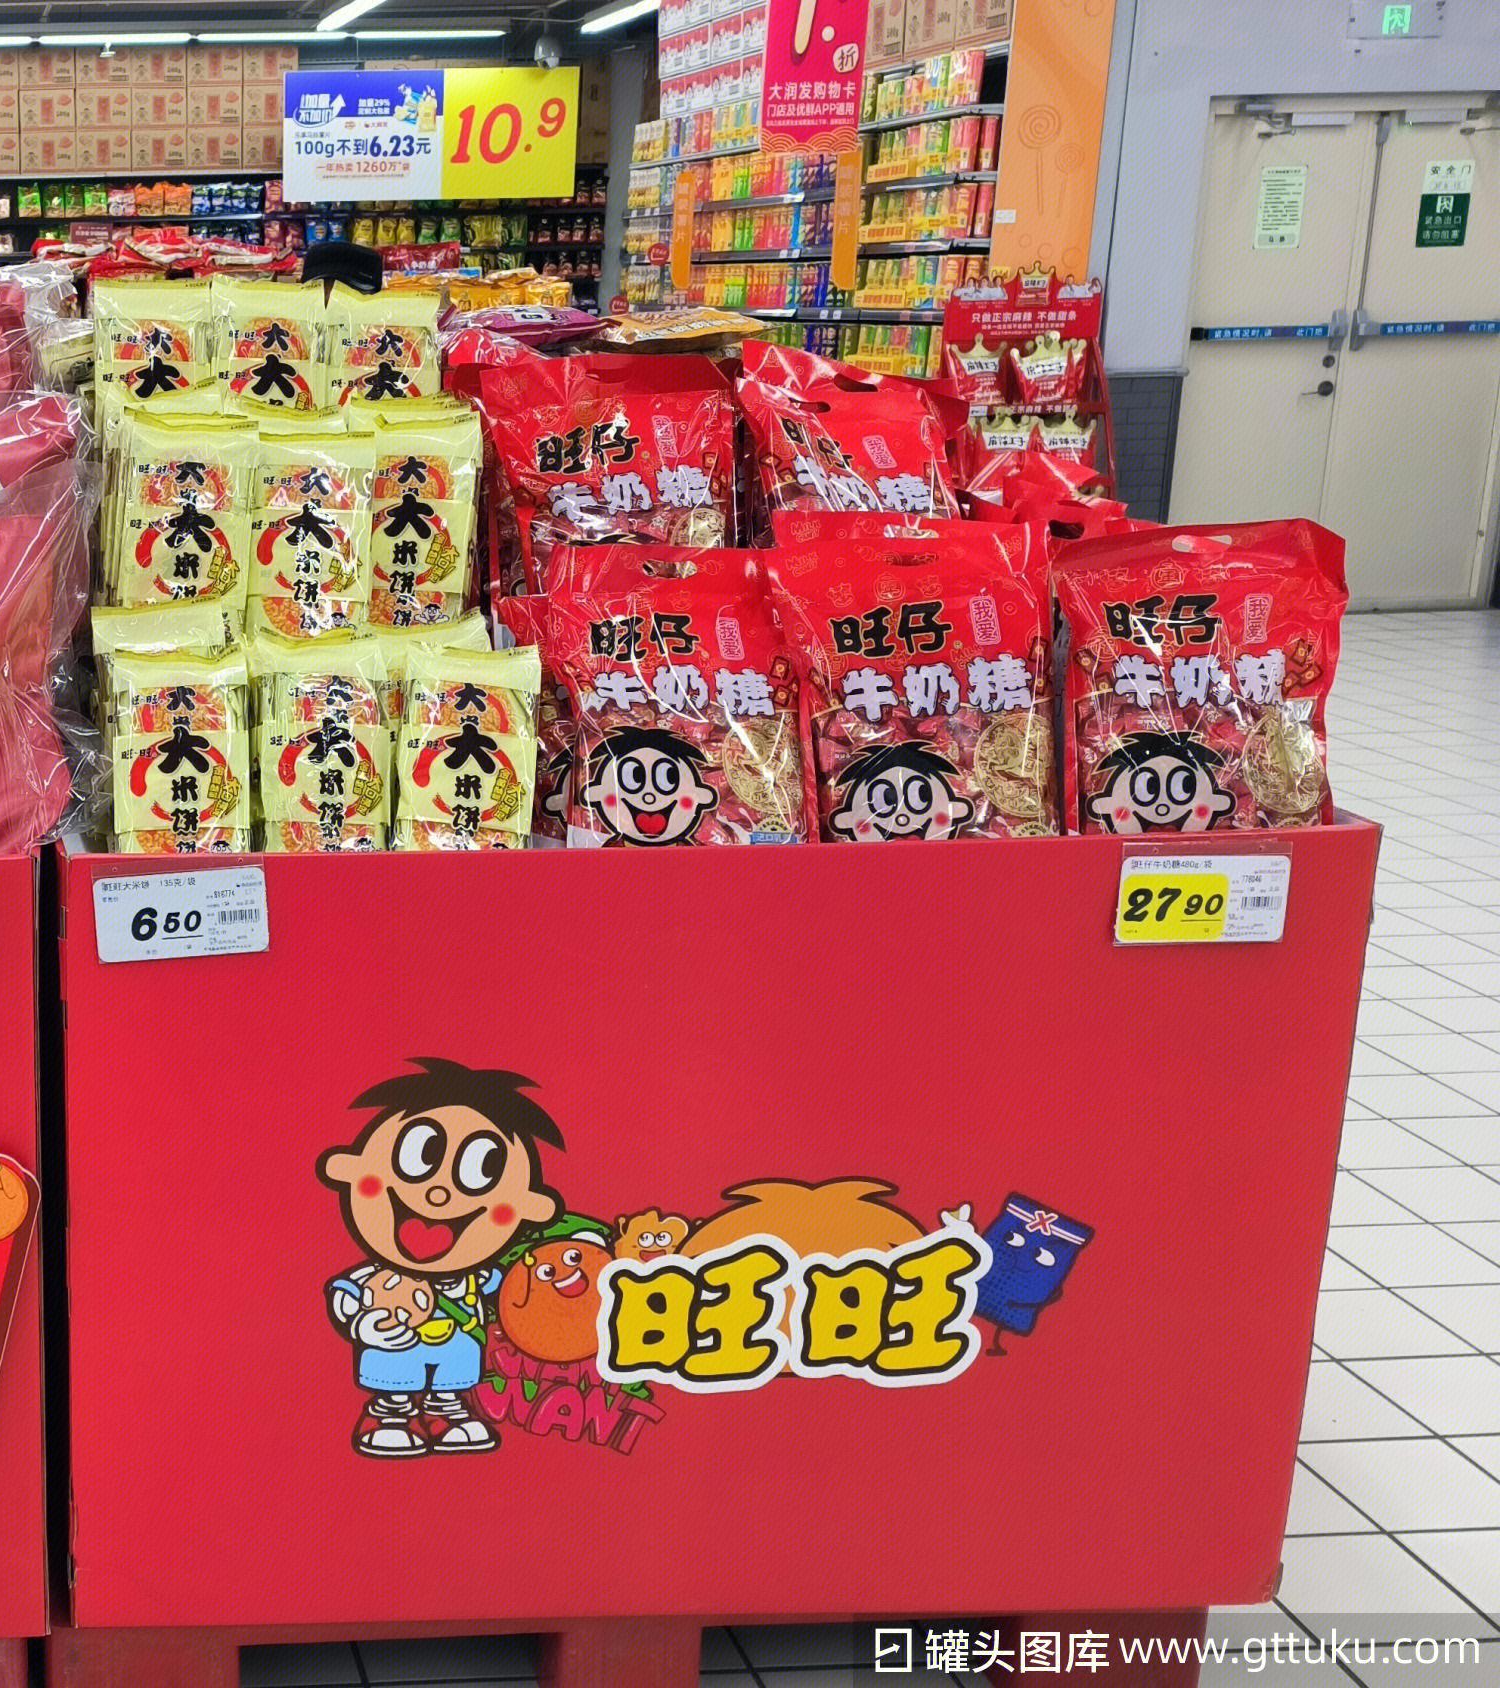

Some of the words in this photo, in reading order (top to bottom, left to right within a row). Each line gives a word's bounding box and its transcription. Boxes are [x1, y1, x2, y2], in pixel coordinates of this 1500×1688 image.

[837, 45, 857, 71] 折
[766, 103, 855, 118] 门店及优鲜APP通用
[768, 80, 857, 101] 大润发购物卡
[450, 97, 567, 165] 10.9
[588, 611, 702, 663] 旺仔
[830, 600, 953, 659] 旺仔
[1102, 594, 1223, 648] 旺仔
[593, 664, 776, 718] 牛奶糖
[841, 653, 1033, 723] 牛奶糖
[156, 725, 211, 834] 大米饼
[442, 723, 499, 834] 大米饼
[608, 1238, 980, 1384] 旺旺
[470, 1378, 667, 1456] WANT
